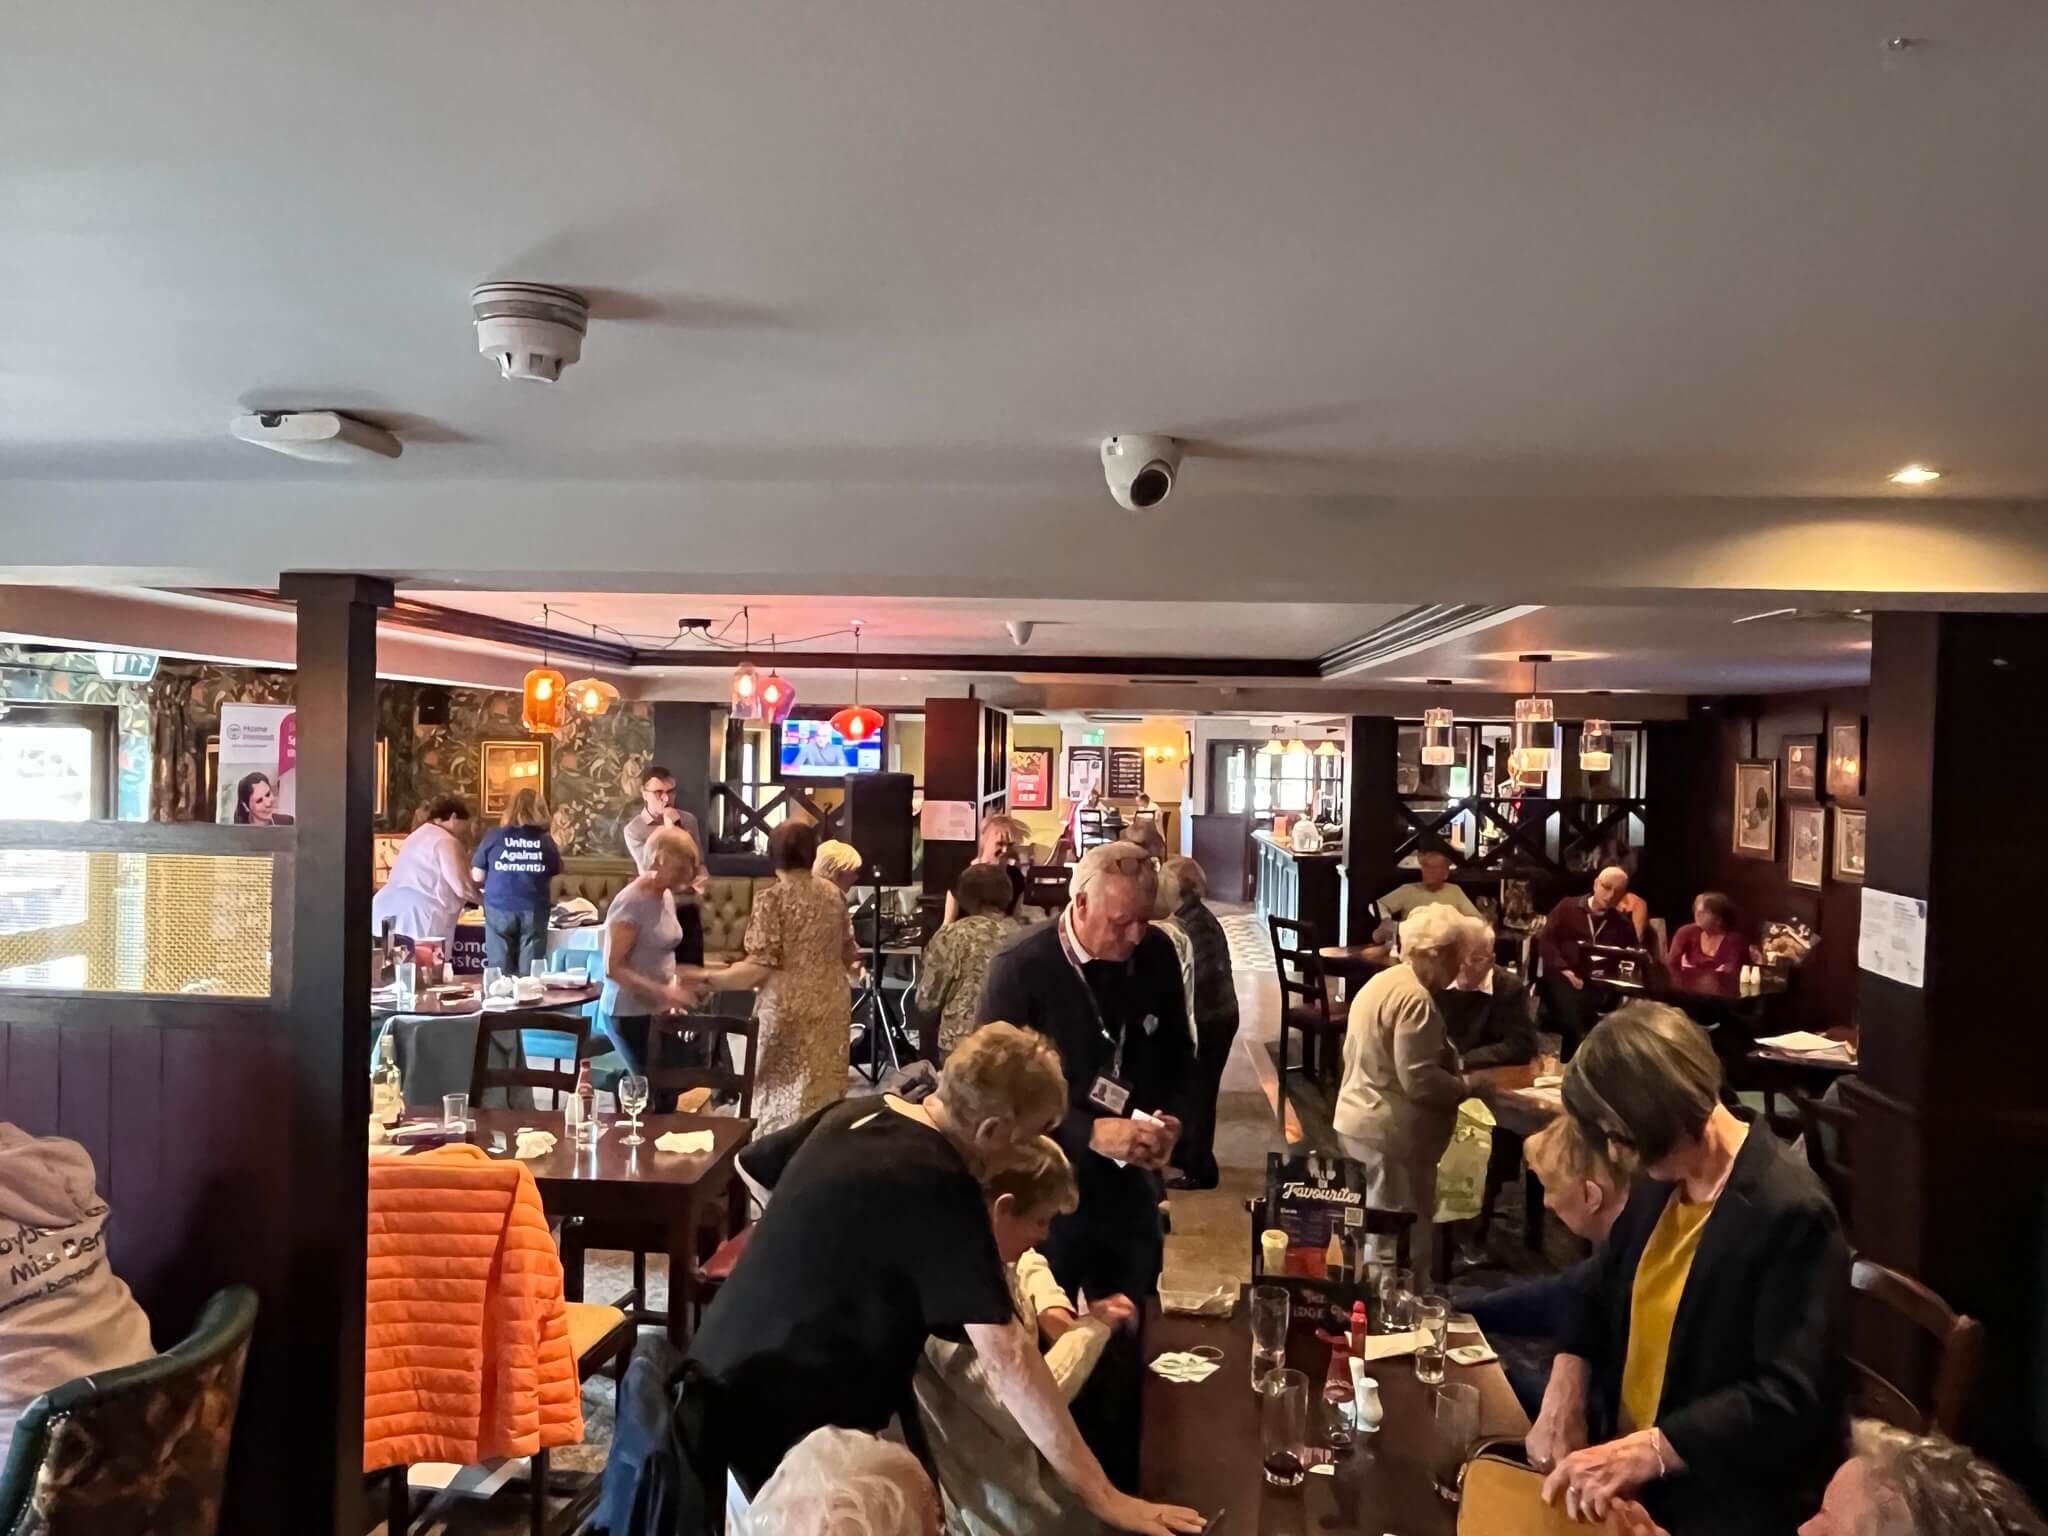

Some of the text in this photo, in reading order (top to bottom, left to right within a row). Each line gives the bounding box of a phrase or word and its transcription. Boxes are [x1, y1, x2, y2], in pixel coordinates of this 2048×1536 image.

[504, 837, 541, 849] United
[500, 849, 543, 862] Against
[1282, 1181, 1361, 1204] Favourites
